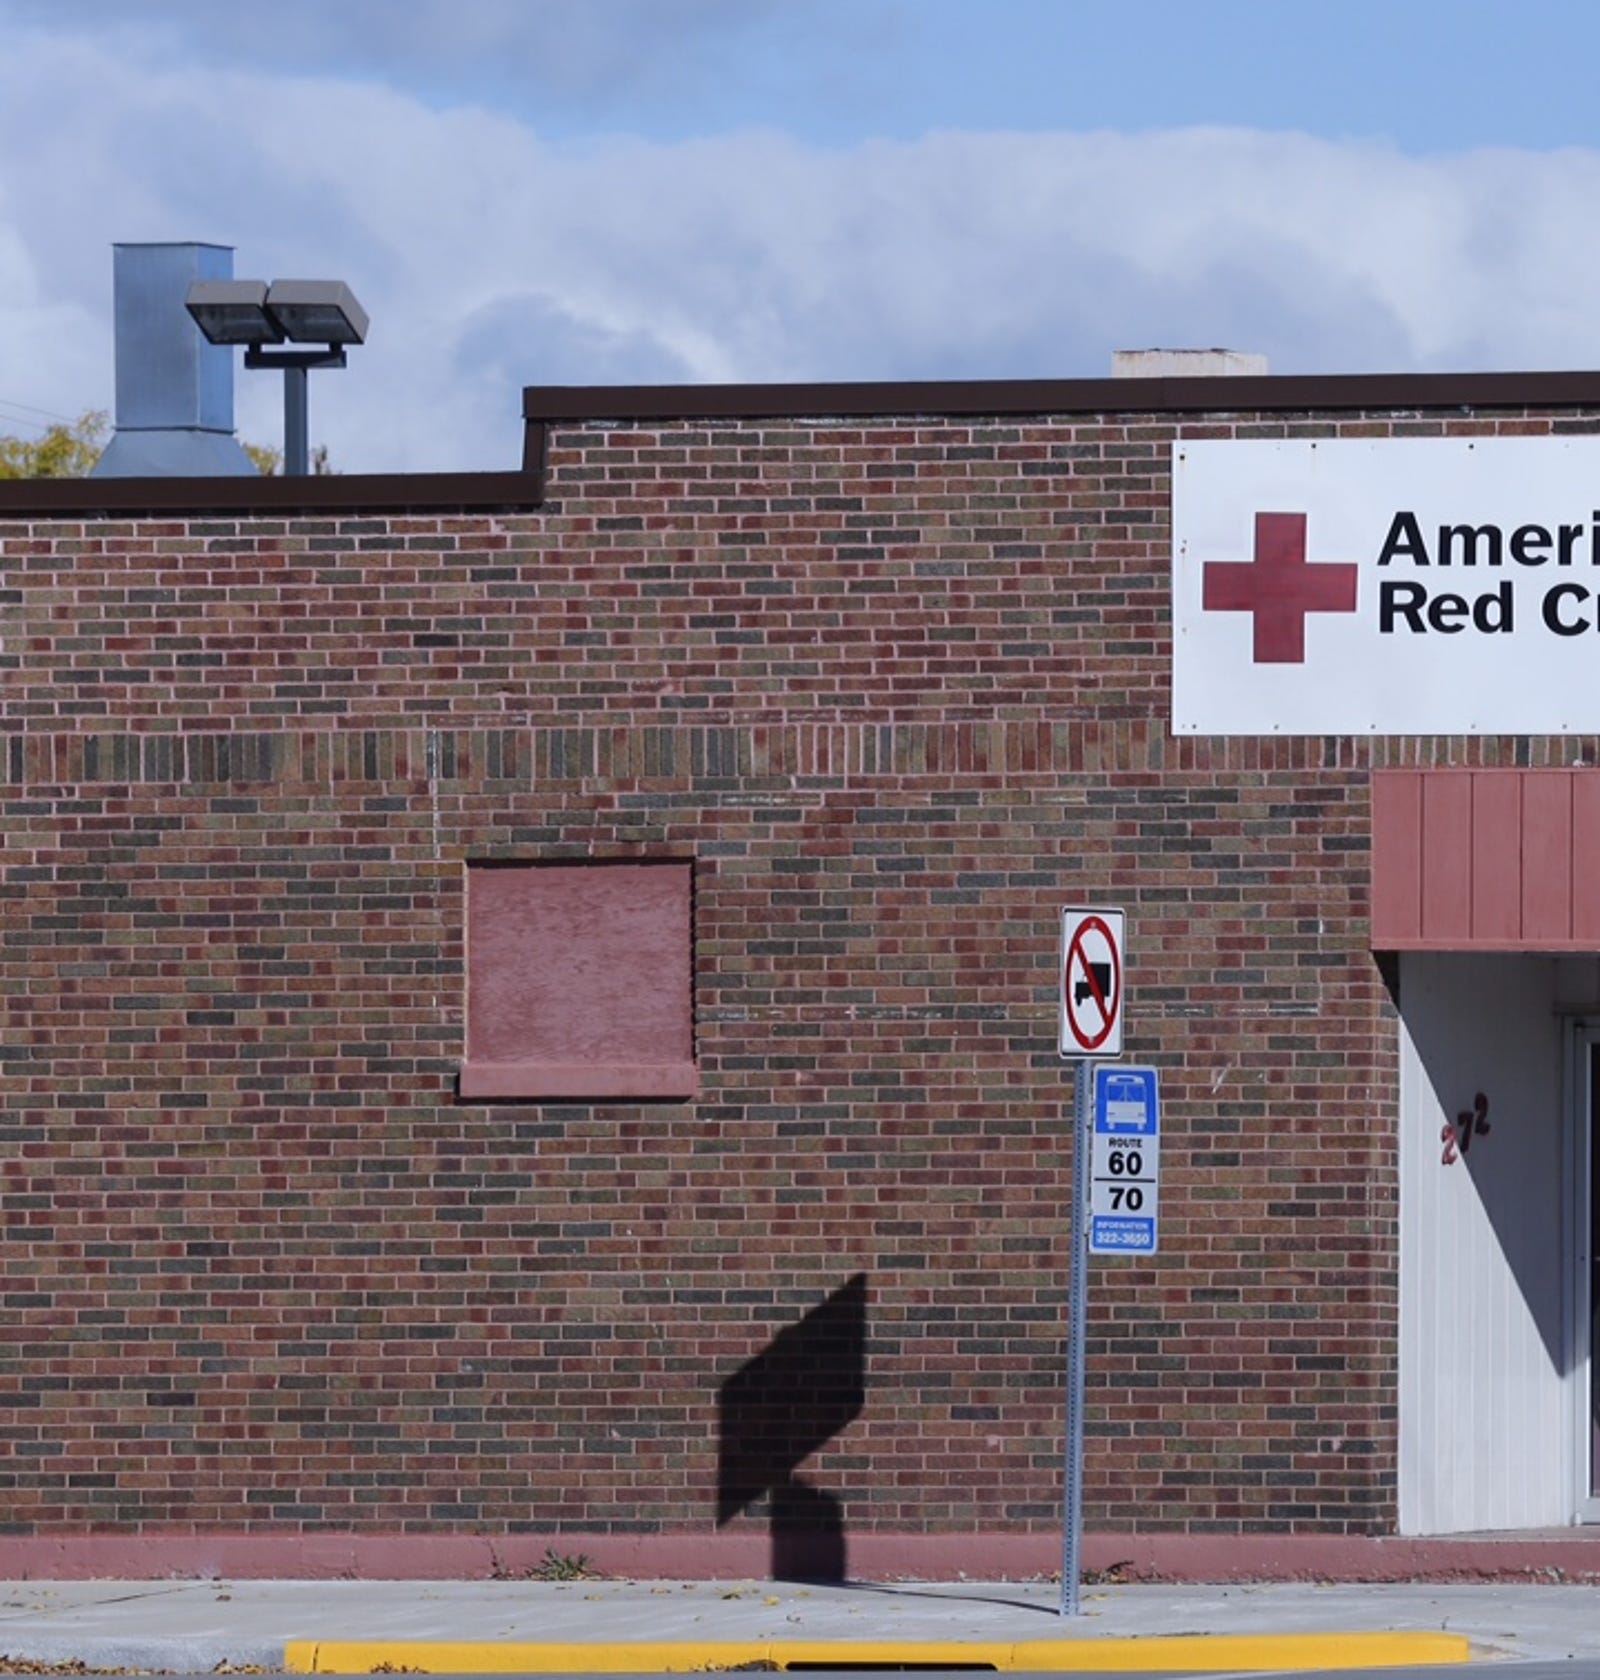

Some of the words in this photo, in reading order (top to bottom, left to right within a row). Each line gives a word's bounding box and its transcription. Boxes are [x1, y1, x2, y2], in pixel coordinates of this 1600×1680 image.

[1379, 580, 1514, 634] Red
[1441, 1091, 1490, 1165] 272
[1108, 1138, 1142, 1148] ROUTE
[1108, 1151, 1143, 1175] 60
[1108, 1187, 1143, 1211] 70
